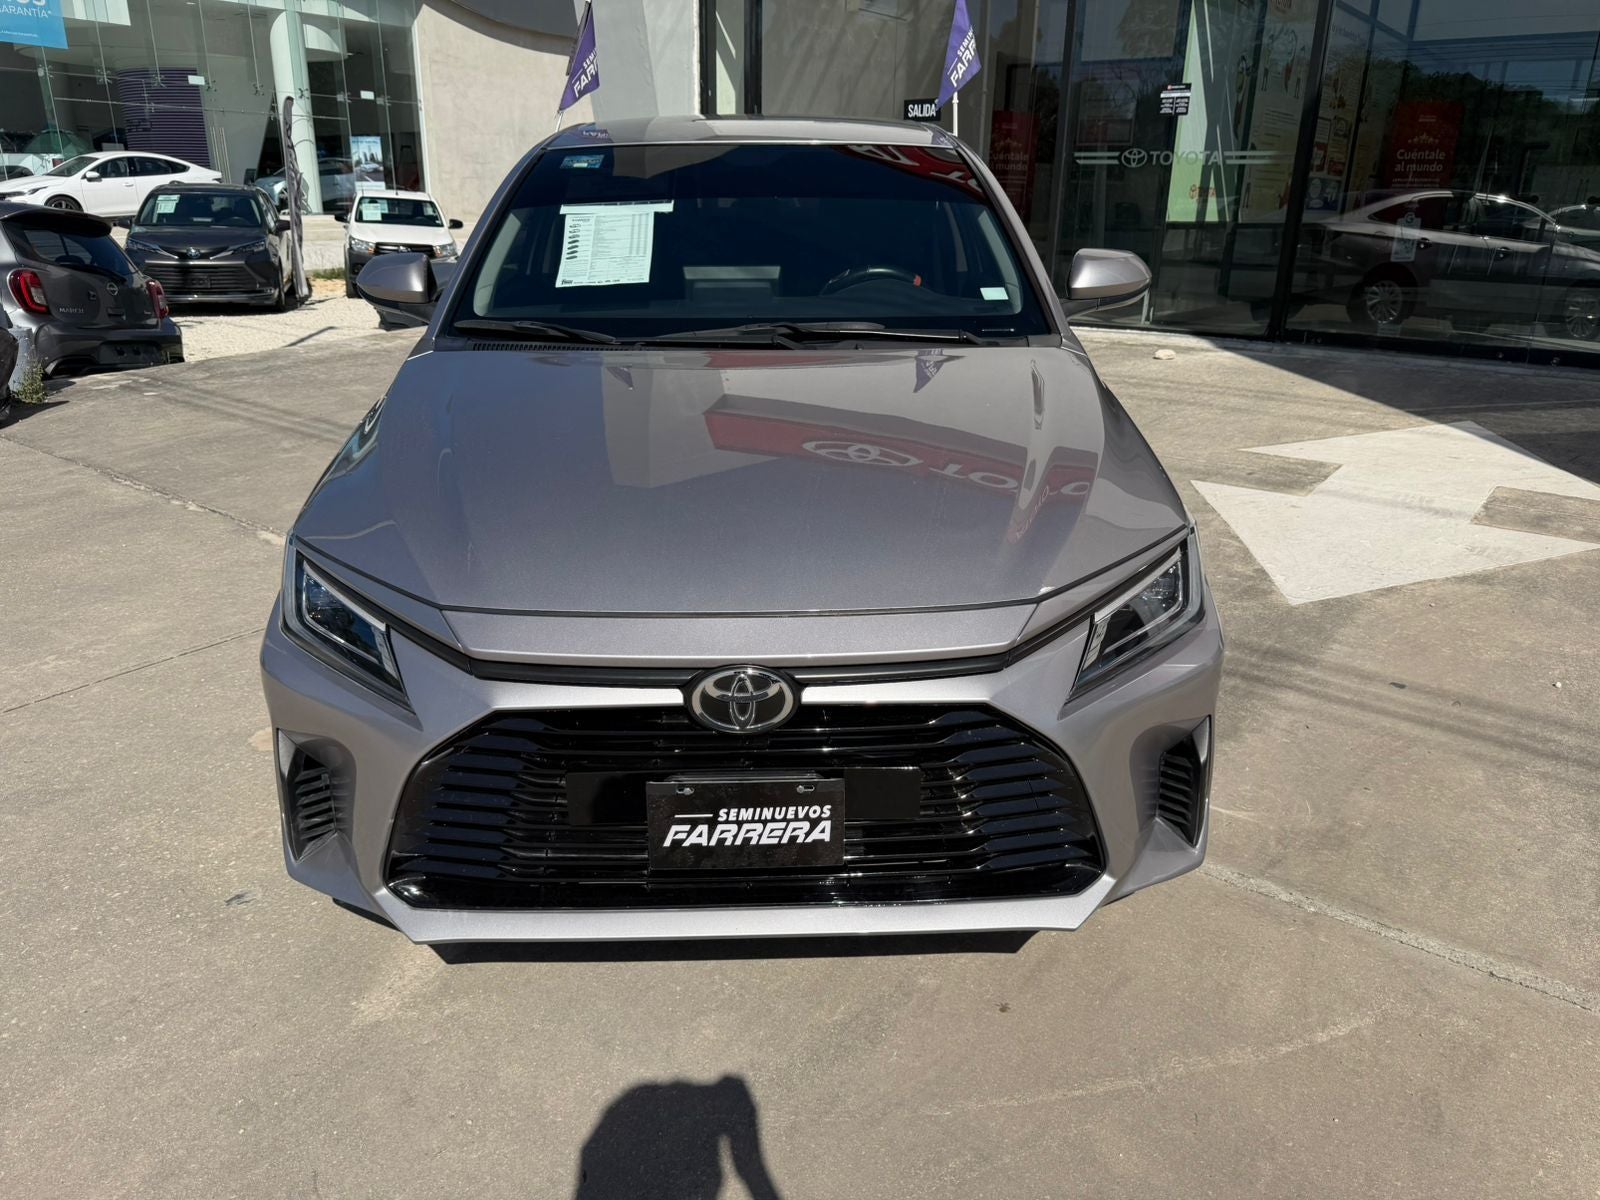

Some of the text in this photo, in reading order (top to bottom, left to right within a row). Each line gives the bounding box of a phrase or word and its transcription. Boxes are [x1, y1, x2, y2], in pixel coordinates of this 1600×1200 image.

[908, 103, 936, 117] SALIDA
[1150, 151, 1222, 166] TOYOTA
[1396, 148, 1446, 160] Cuéntale
[1394, 160, 1444, 172] al mundo
[717, 804, 832, 822] SEMINUEVOS
[662, 819, 832, 848] FARRERA
